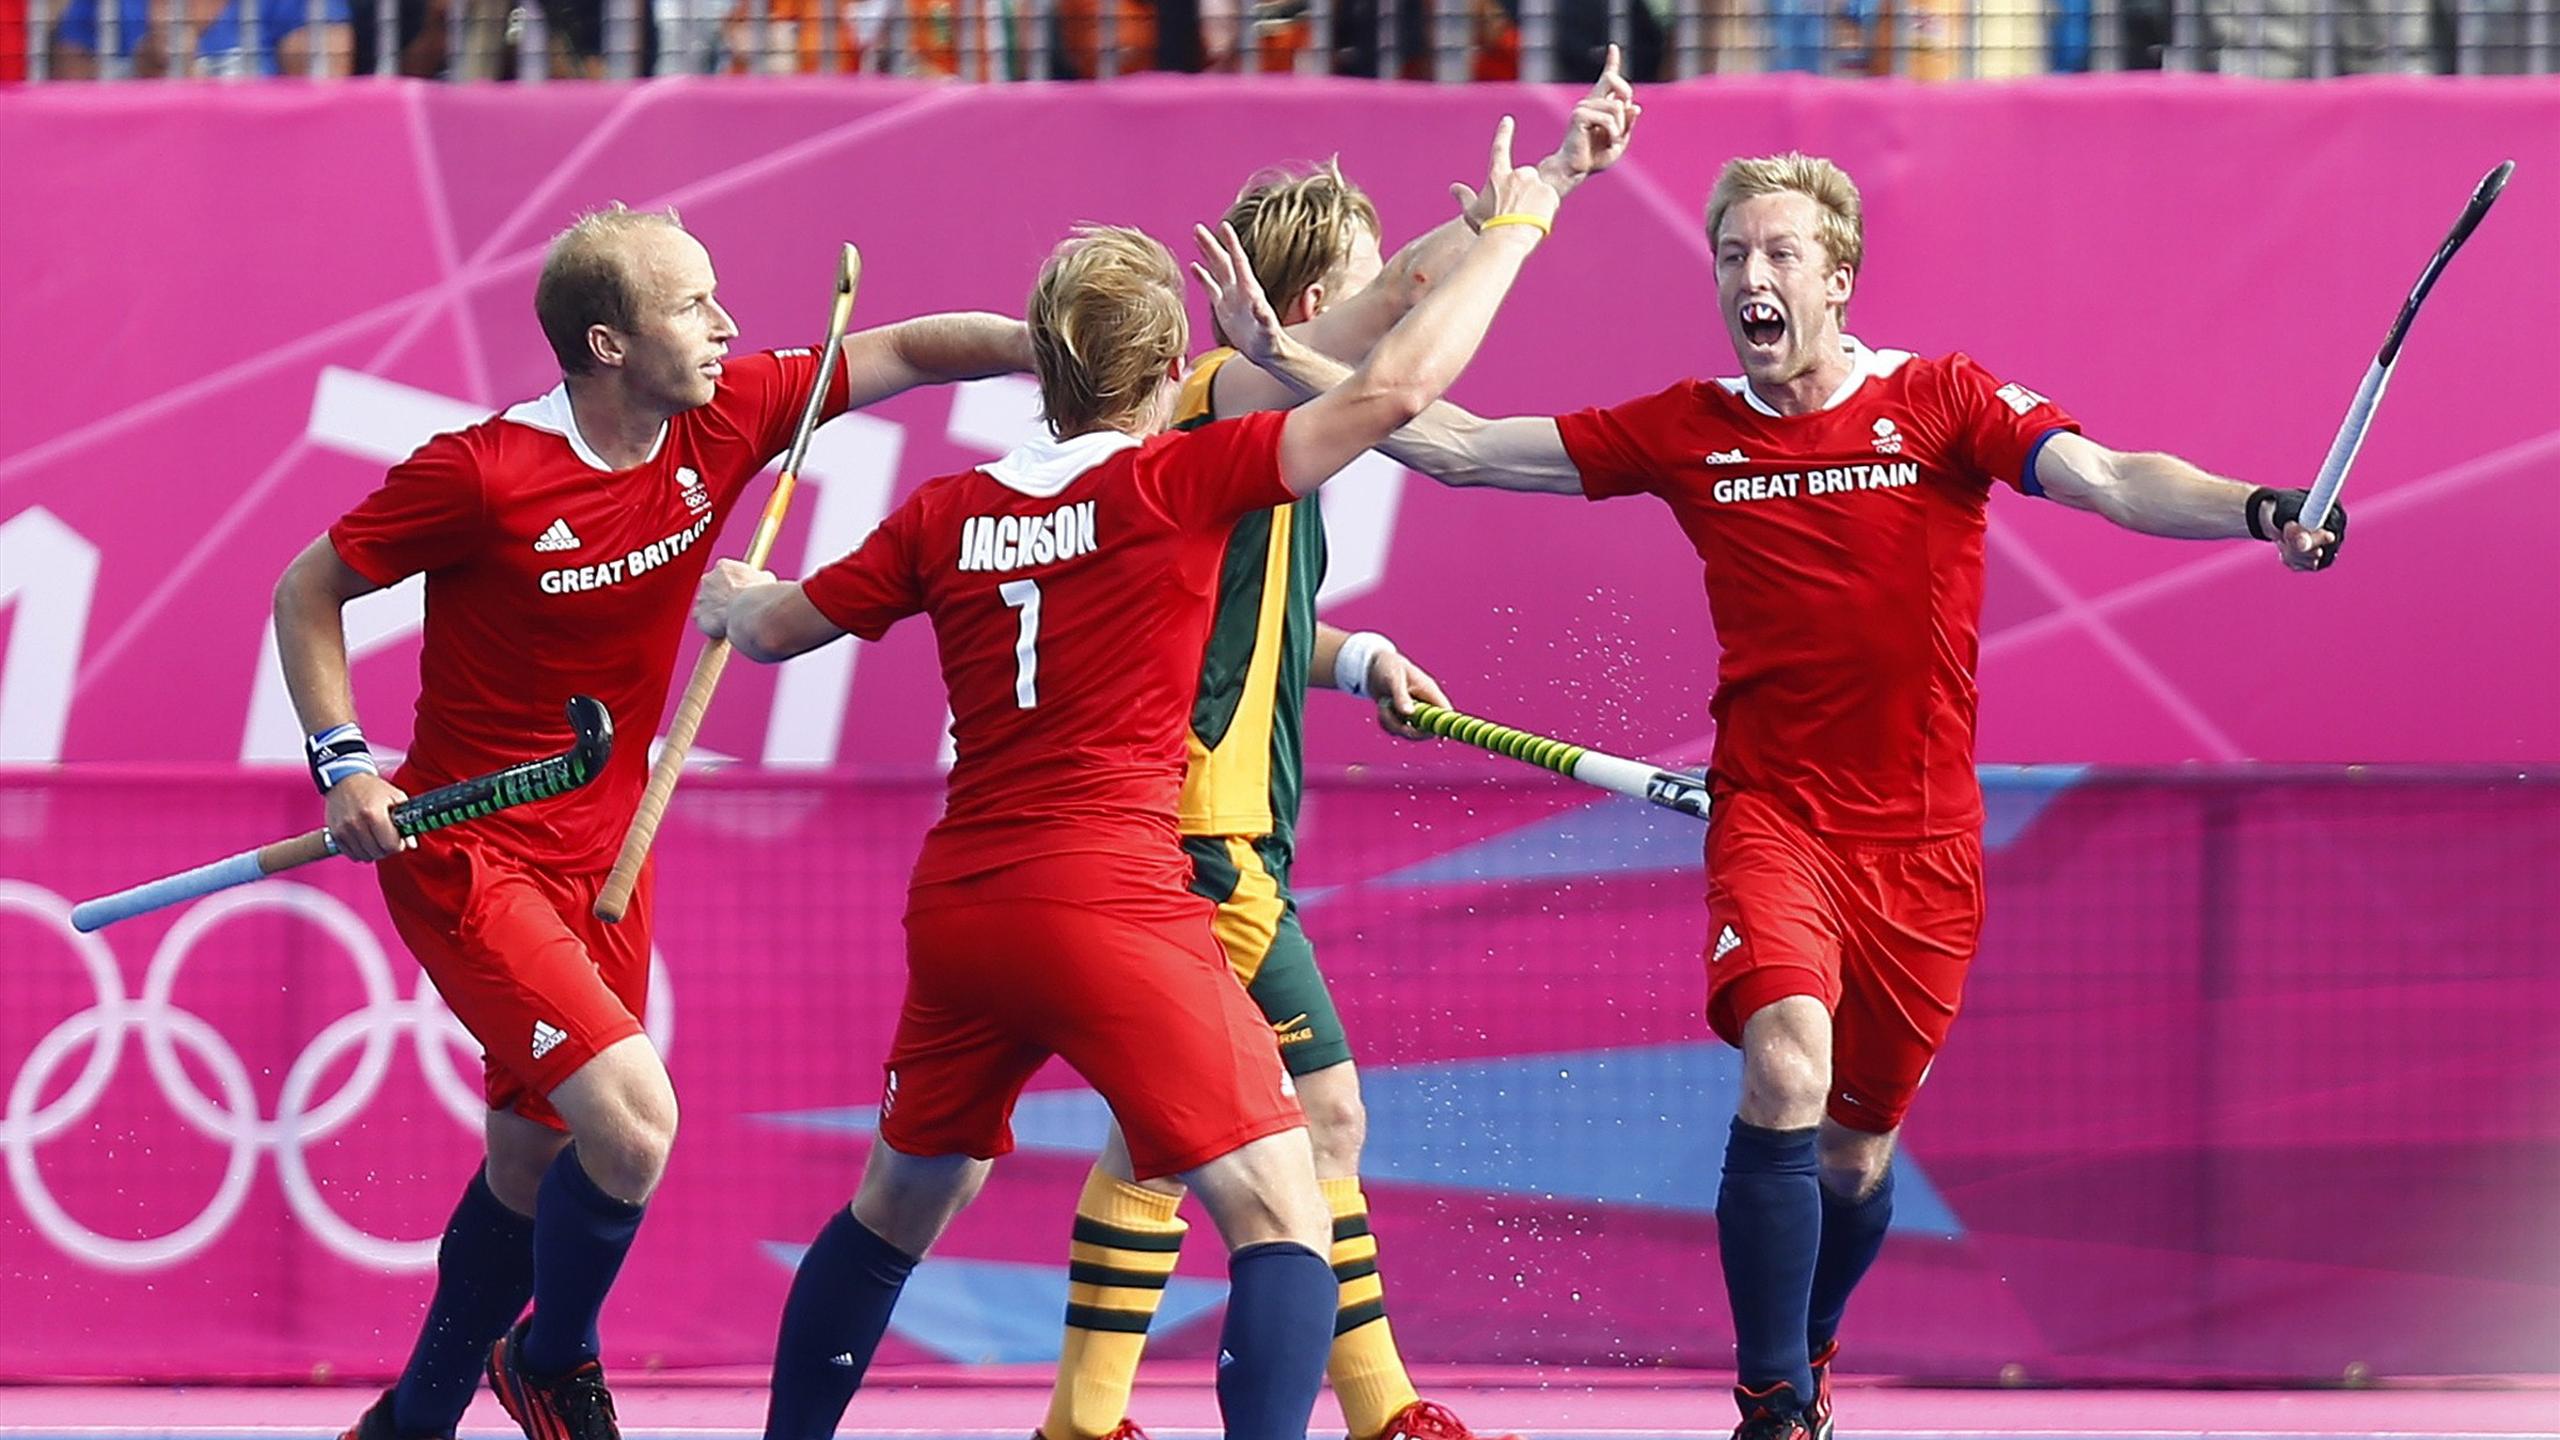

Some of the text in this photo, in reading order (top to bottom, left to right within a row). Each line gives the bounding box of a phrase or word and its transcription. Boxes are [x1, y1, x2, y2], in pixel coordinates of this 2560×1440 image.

[1713, 463, 1919, 503] GREAT BRITAIN
[958, 500, 1098, 571] JACKSON
[540, 559, 625, 594] GREAT
[999, 578, 1041, 709] 7
